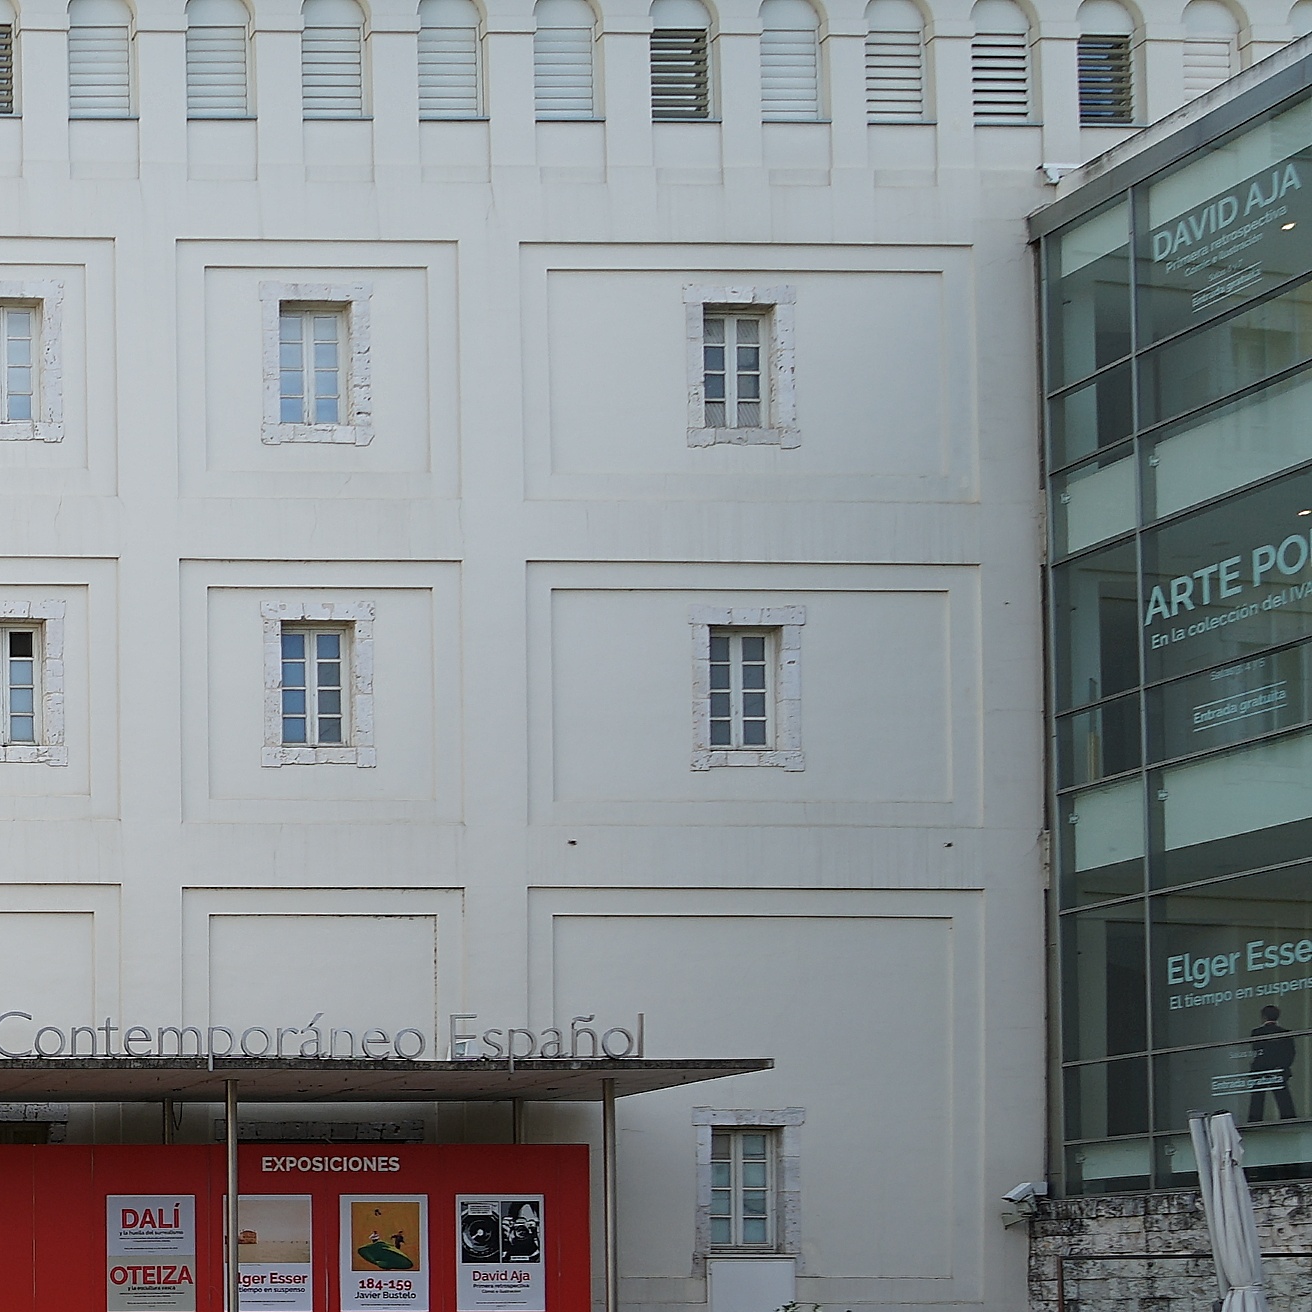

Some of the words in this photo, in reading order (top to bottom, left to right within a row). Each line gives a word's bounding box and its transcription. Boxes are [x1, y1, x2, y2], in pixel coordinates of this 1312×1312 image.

[1152, 195, 1239, 263] DAVID
[1243, 163, 1302, 217] AJA
[1165, 245, 1210, 274] Primera
[1210, 205, 1288, 251] retrospectiva
[1143, 555, 1243, 627] ARTE
[1252, 528, 1312, 588] PO
[1151, 633, 1169, 649] En
[1172, 628, 1186, 642] la
[1187, 603, 1259, 637] colección
[1262, 594, 1287, 611] del
[1193, 702, 1238, 724] Entrada
[1239, 689, 1287, 713] gratuita
[1167, 952, 1241, 989] Elger
[1246, 939, 1312, 972] Esse
[1170, 995, 1183, 1010] El
[1184, 990, 1232, 1007] tiempo
[1235, 986, 1253, 999] en
[1255, 976, 1312, 996] suspens
[449, 1011, 645, 1074] Español
[261, 1156, 401, 1172] EXPOSICIONES
[121, 1203, 181, 1229] DALÍ
[109, 1265, 194, 1285] OTEIZA
[237, 1272, 267, 1287] lger
[269, 1272, 308, 1284] Esser
[358, 1278, 412, 1291] 184-159
[472, 1270, 508, 1281] David
[510, 1270, 530, 1283] Aja
[354, 1291, 381, 1299] Javier
[382, 1291, 417, 1299] Bustelo
